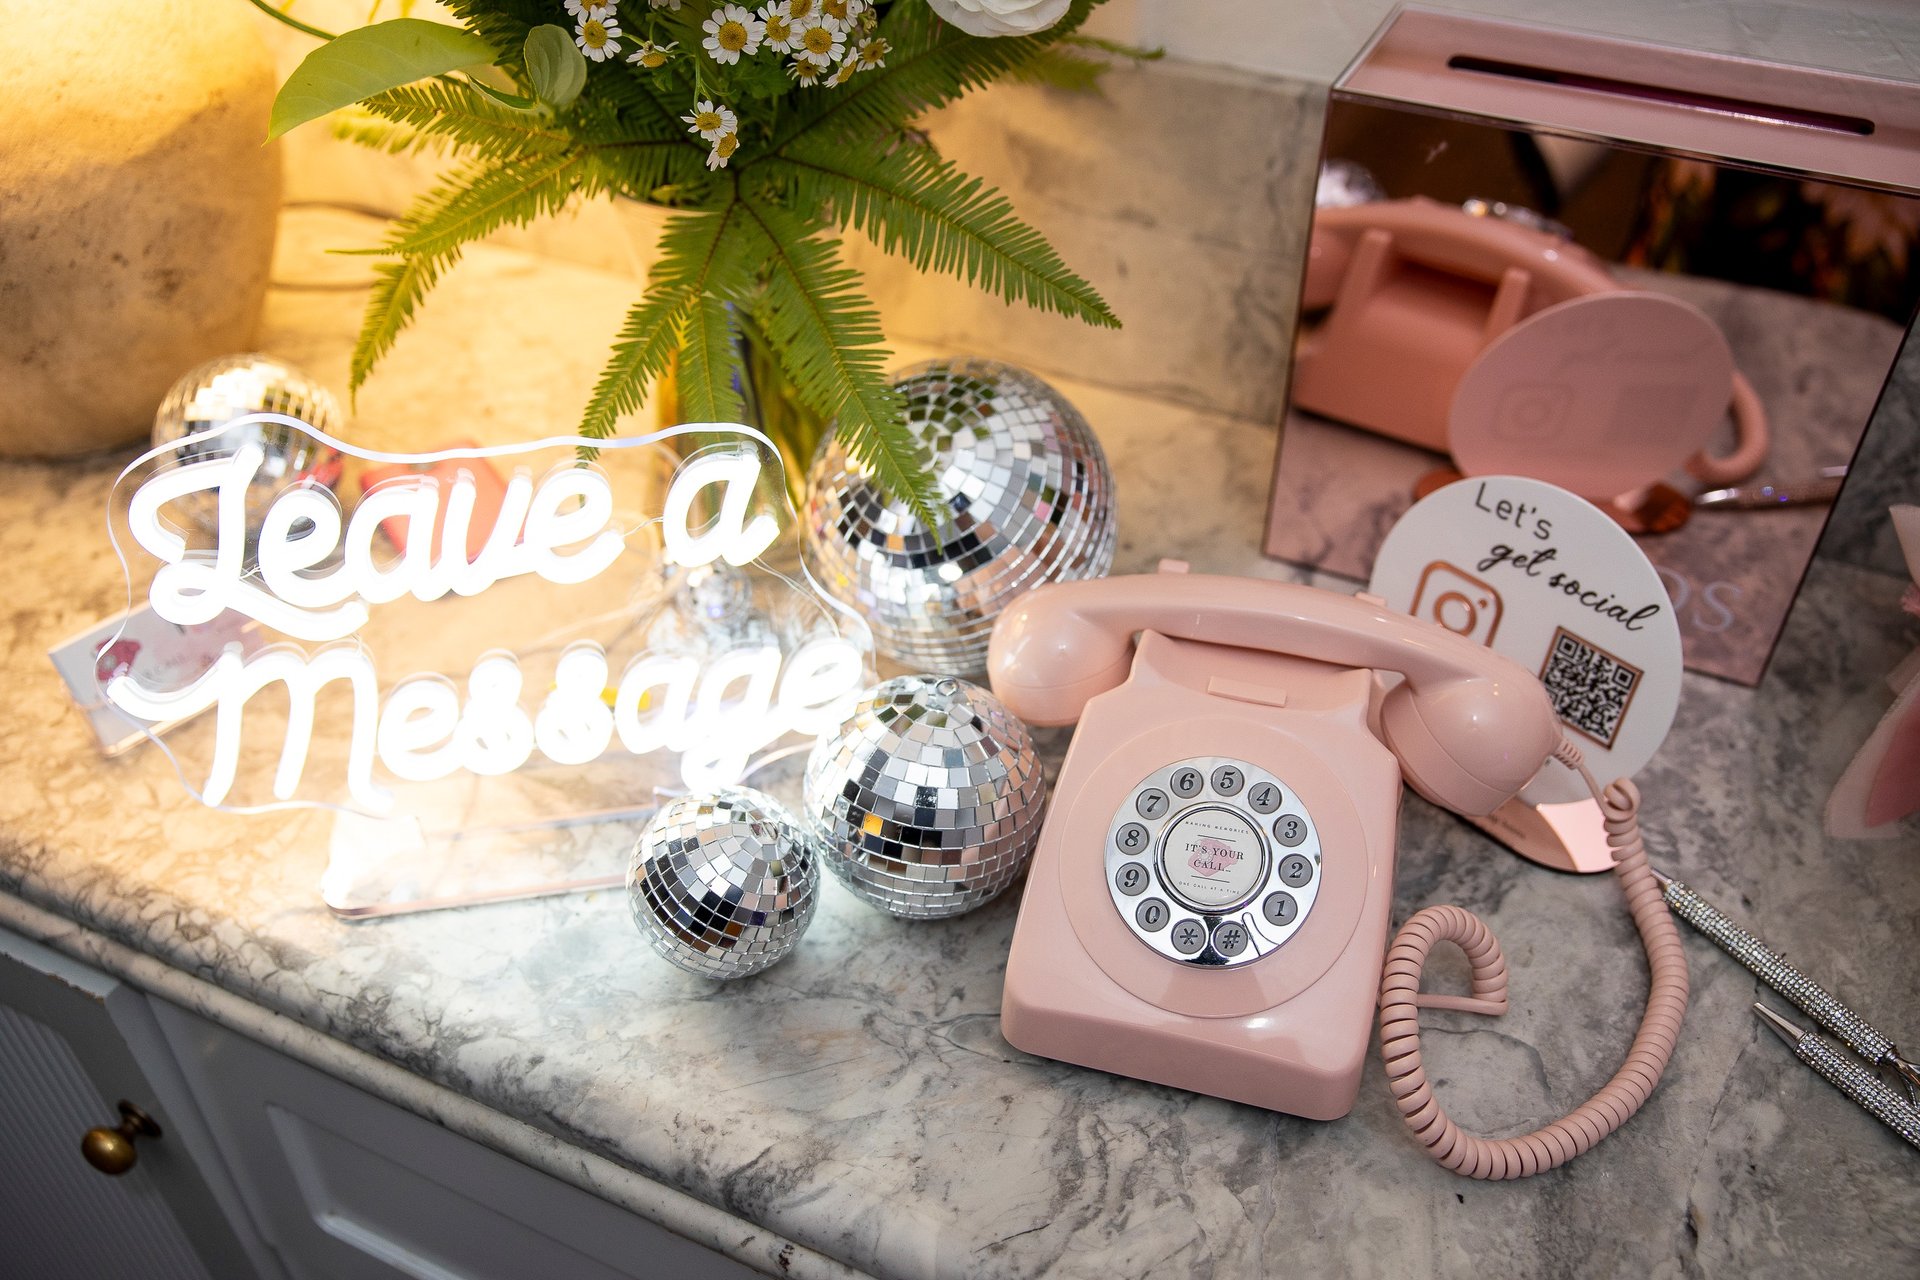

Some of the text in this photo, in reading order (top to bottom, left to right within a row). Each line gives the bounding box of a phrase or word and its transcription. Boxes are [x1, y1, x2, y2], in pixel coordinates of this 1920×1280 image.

[1474, 481, 1553, 541] Let's
[129, 443, 780, 642] Leave a
[1477, 543, 1661, 632] get social
[109, 640, 865, 807] Message
[1179, 772, 1195, 791] 6
[1219, 771, 1236, 789] 5
[1146, 794, 1162, 813] 7
[1257, 787, 1271, 806] 4
[1124, 829, 1140, 848] 8
[1284, 820, 1299, 839] 3
[1185, 843, 1244, 860] IT'S YOUR
[1124, 869, 1140, 888] 9
[1289, 862, 1304, 879] 2
[1145, 905, 1161, 925] 0
[1273, 899, 1286, 917] 1
[1222, 929, 1241, 949] #
